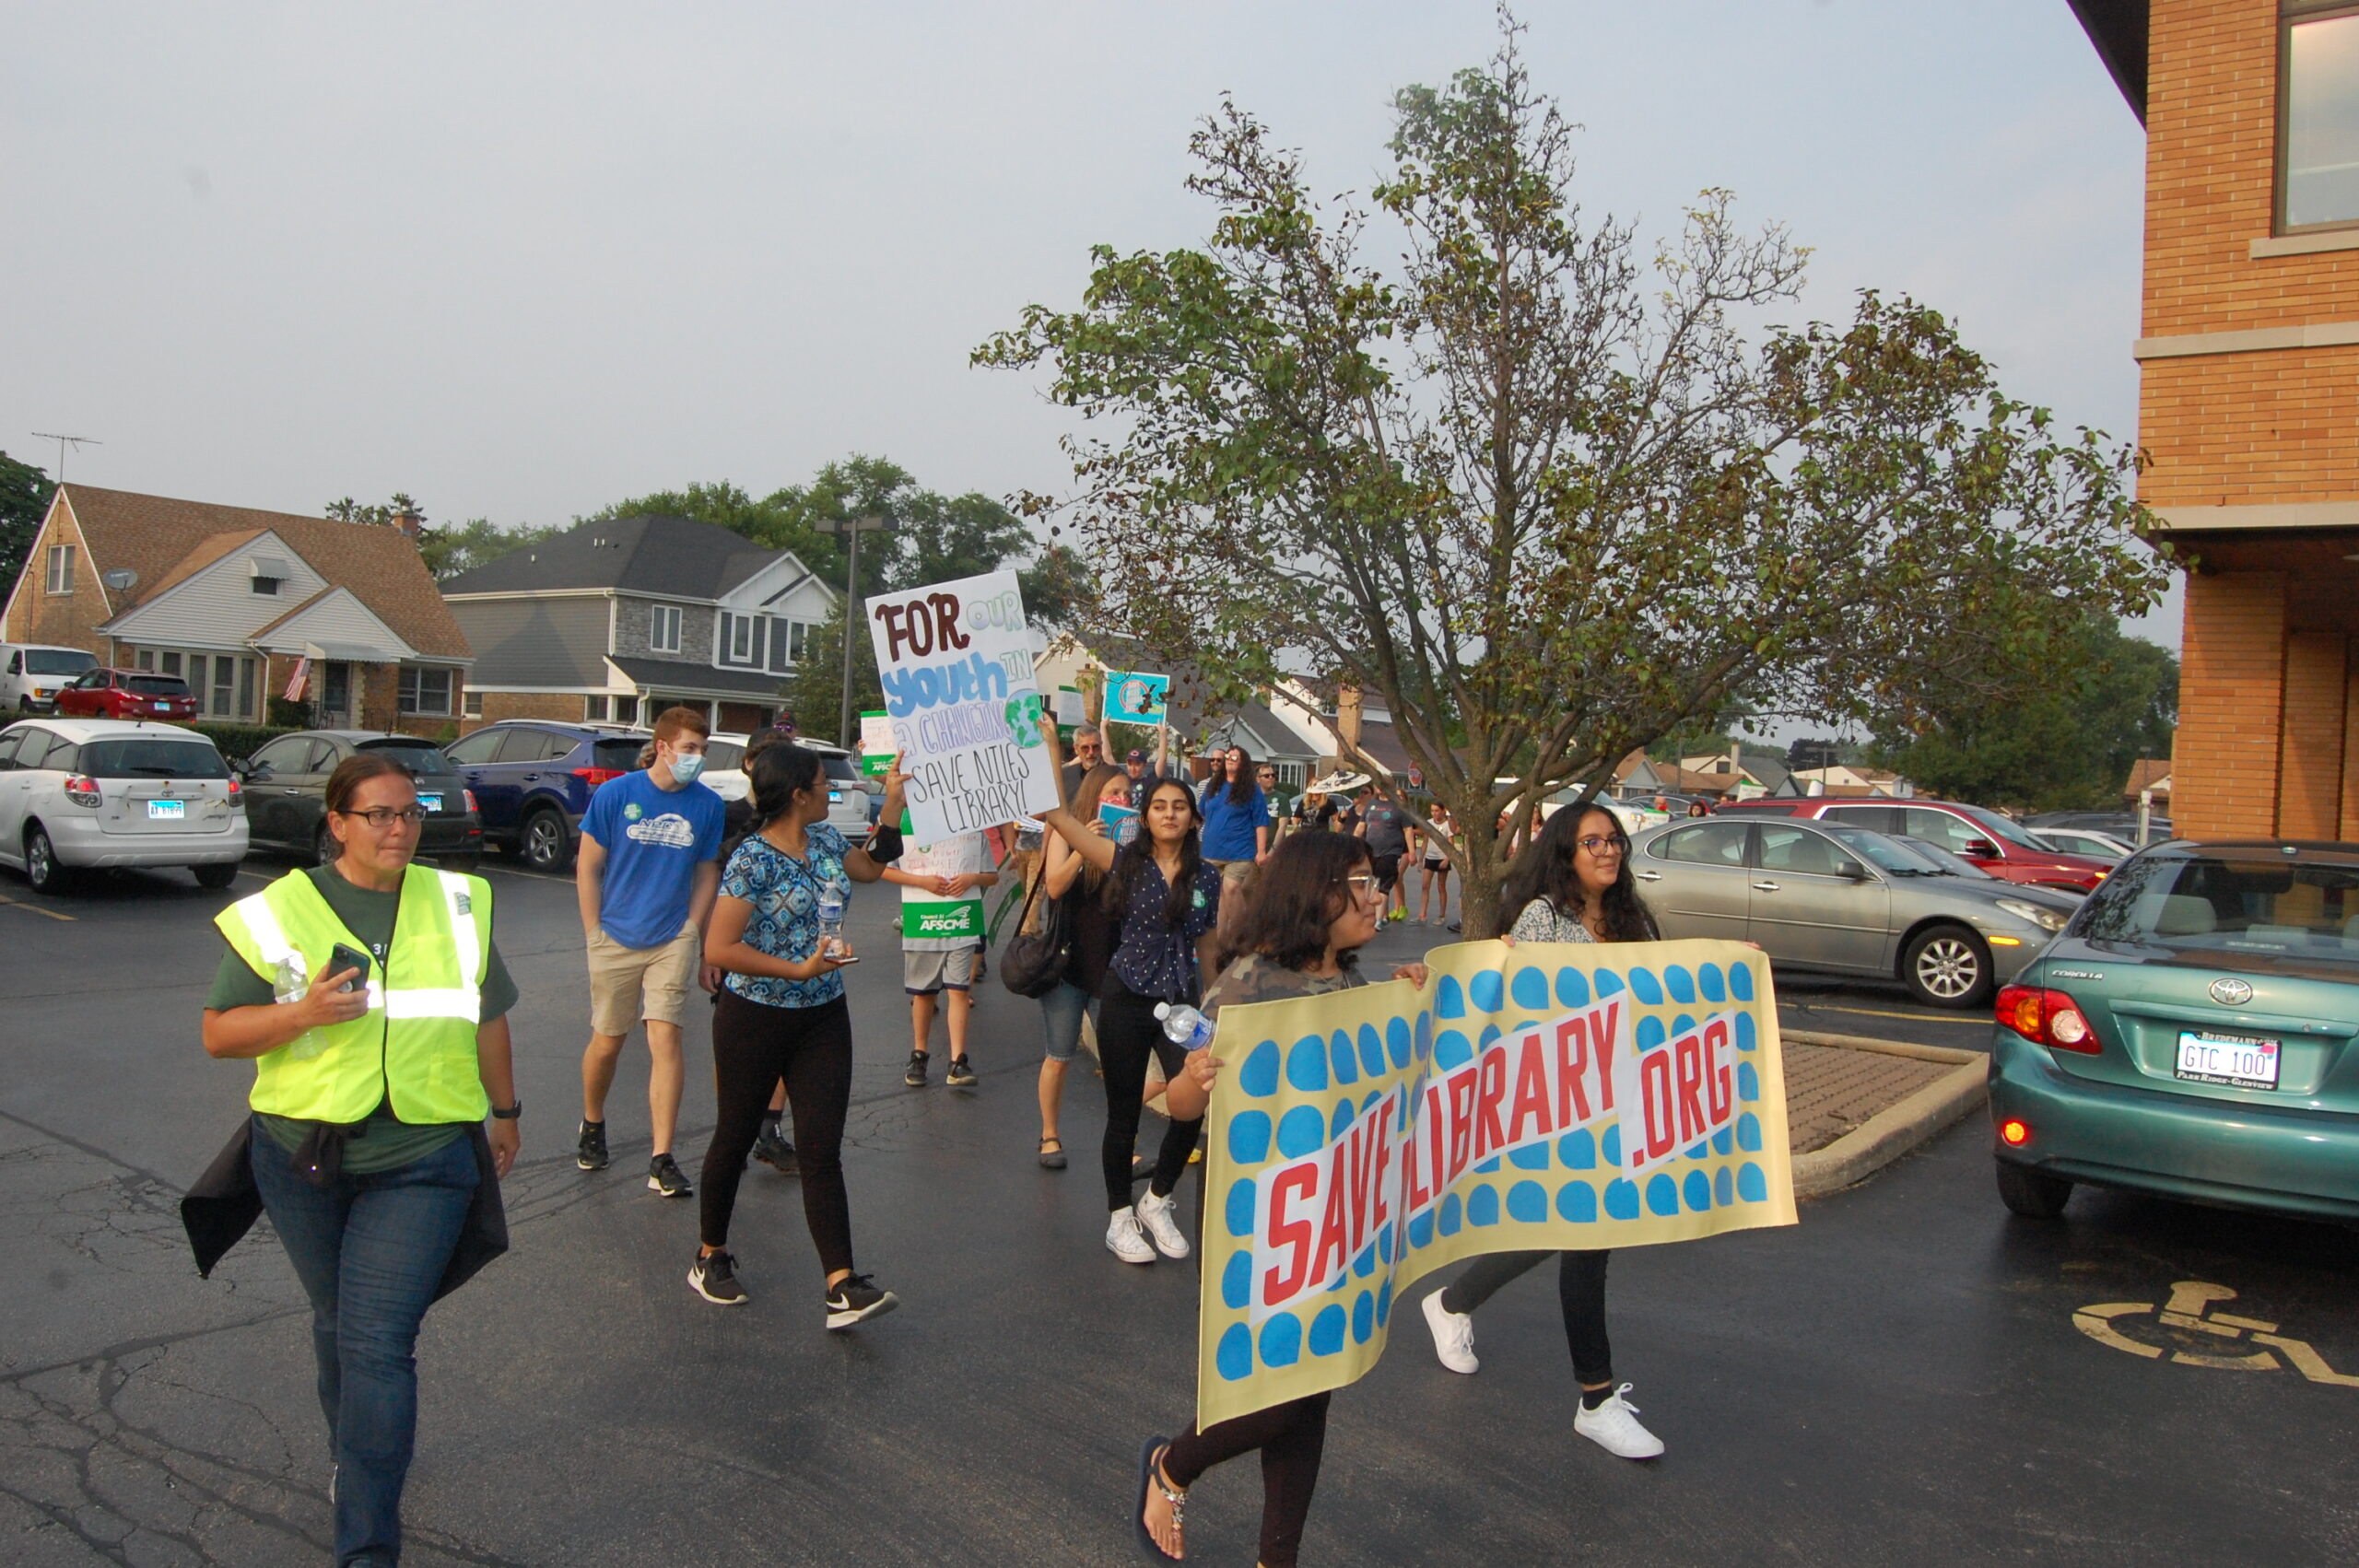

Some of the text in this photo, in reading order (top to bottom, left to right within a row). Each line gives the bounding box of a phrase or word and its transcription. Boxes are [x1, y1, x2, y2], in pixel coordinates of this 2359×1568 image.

[874, 591, 1023, 662] FOR OUR
[1000, 649, 1032, 684] IN
[911, 743, 1030, 803] SAVE NILES
[941, 779, 1029, 833] LIBRARY!
[920, 918, 970, 930] AFSCME
[2184, 1046, 2266, 1076] GTC 100
[1263, 1094, 1395, 1306] SAVE
